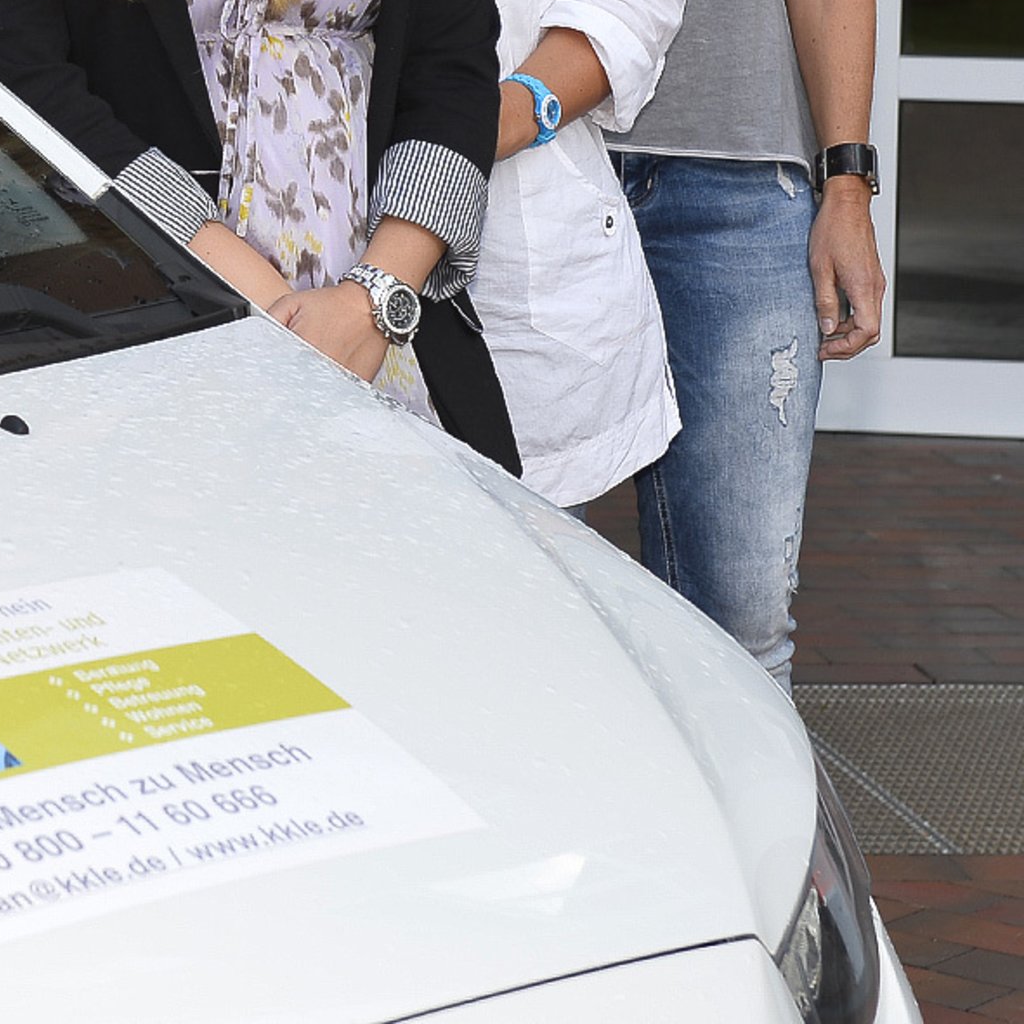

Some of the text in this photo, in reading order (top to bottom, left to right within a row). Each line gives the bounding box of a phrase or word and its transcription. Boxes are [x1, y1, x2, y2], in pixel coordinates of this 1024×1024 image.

[57, 611, 107, 631] und
[89, 677, 151, 696] Pflege
[108, 684, 206, 709] Betreuung
[125, 701, 203, 723] Wohnen
[143, 716, 214, 738] Service
[128, 773, 177, 796] zu
[174, 742, 313, 785] Mensch
[14, 829, 84, 863] 800
[116, 810, 161, 836] 11
[162, 799, 212, 826] 60
[211, 784, 279, 815] 666
[185, 810, 365, 862] www.kkle.de
